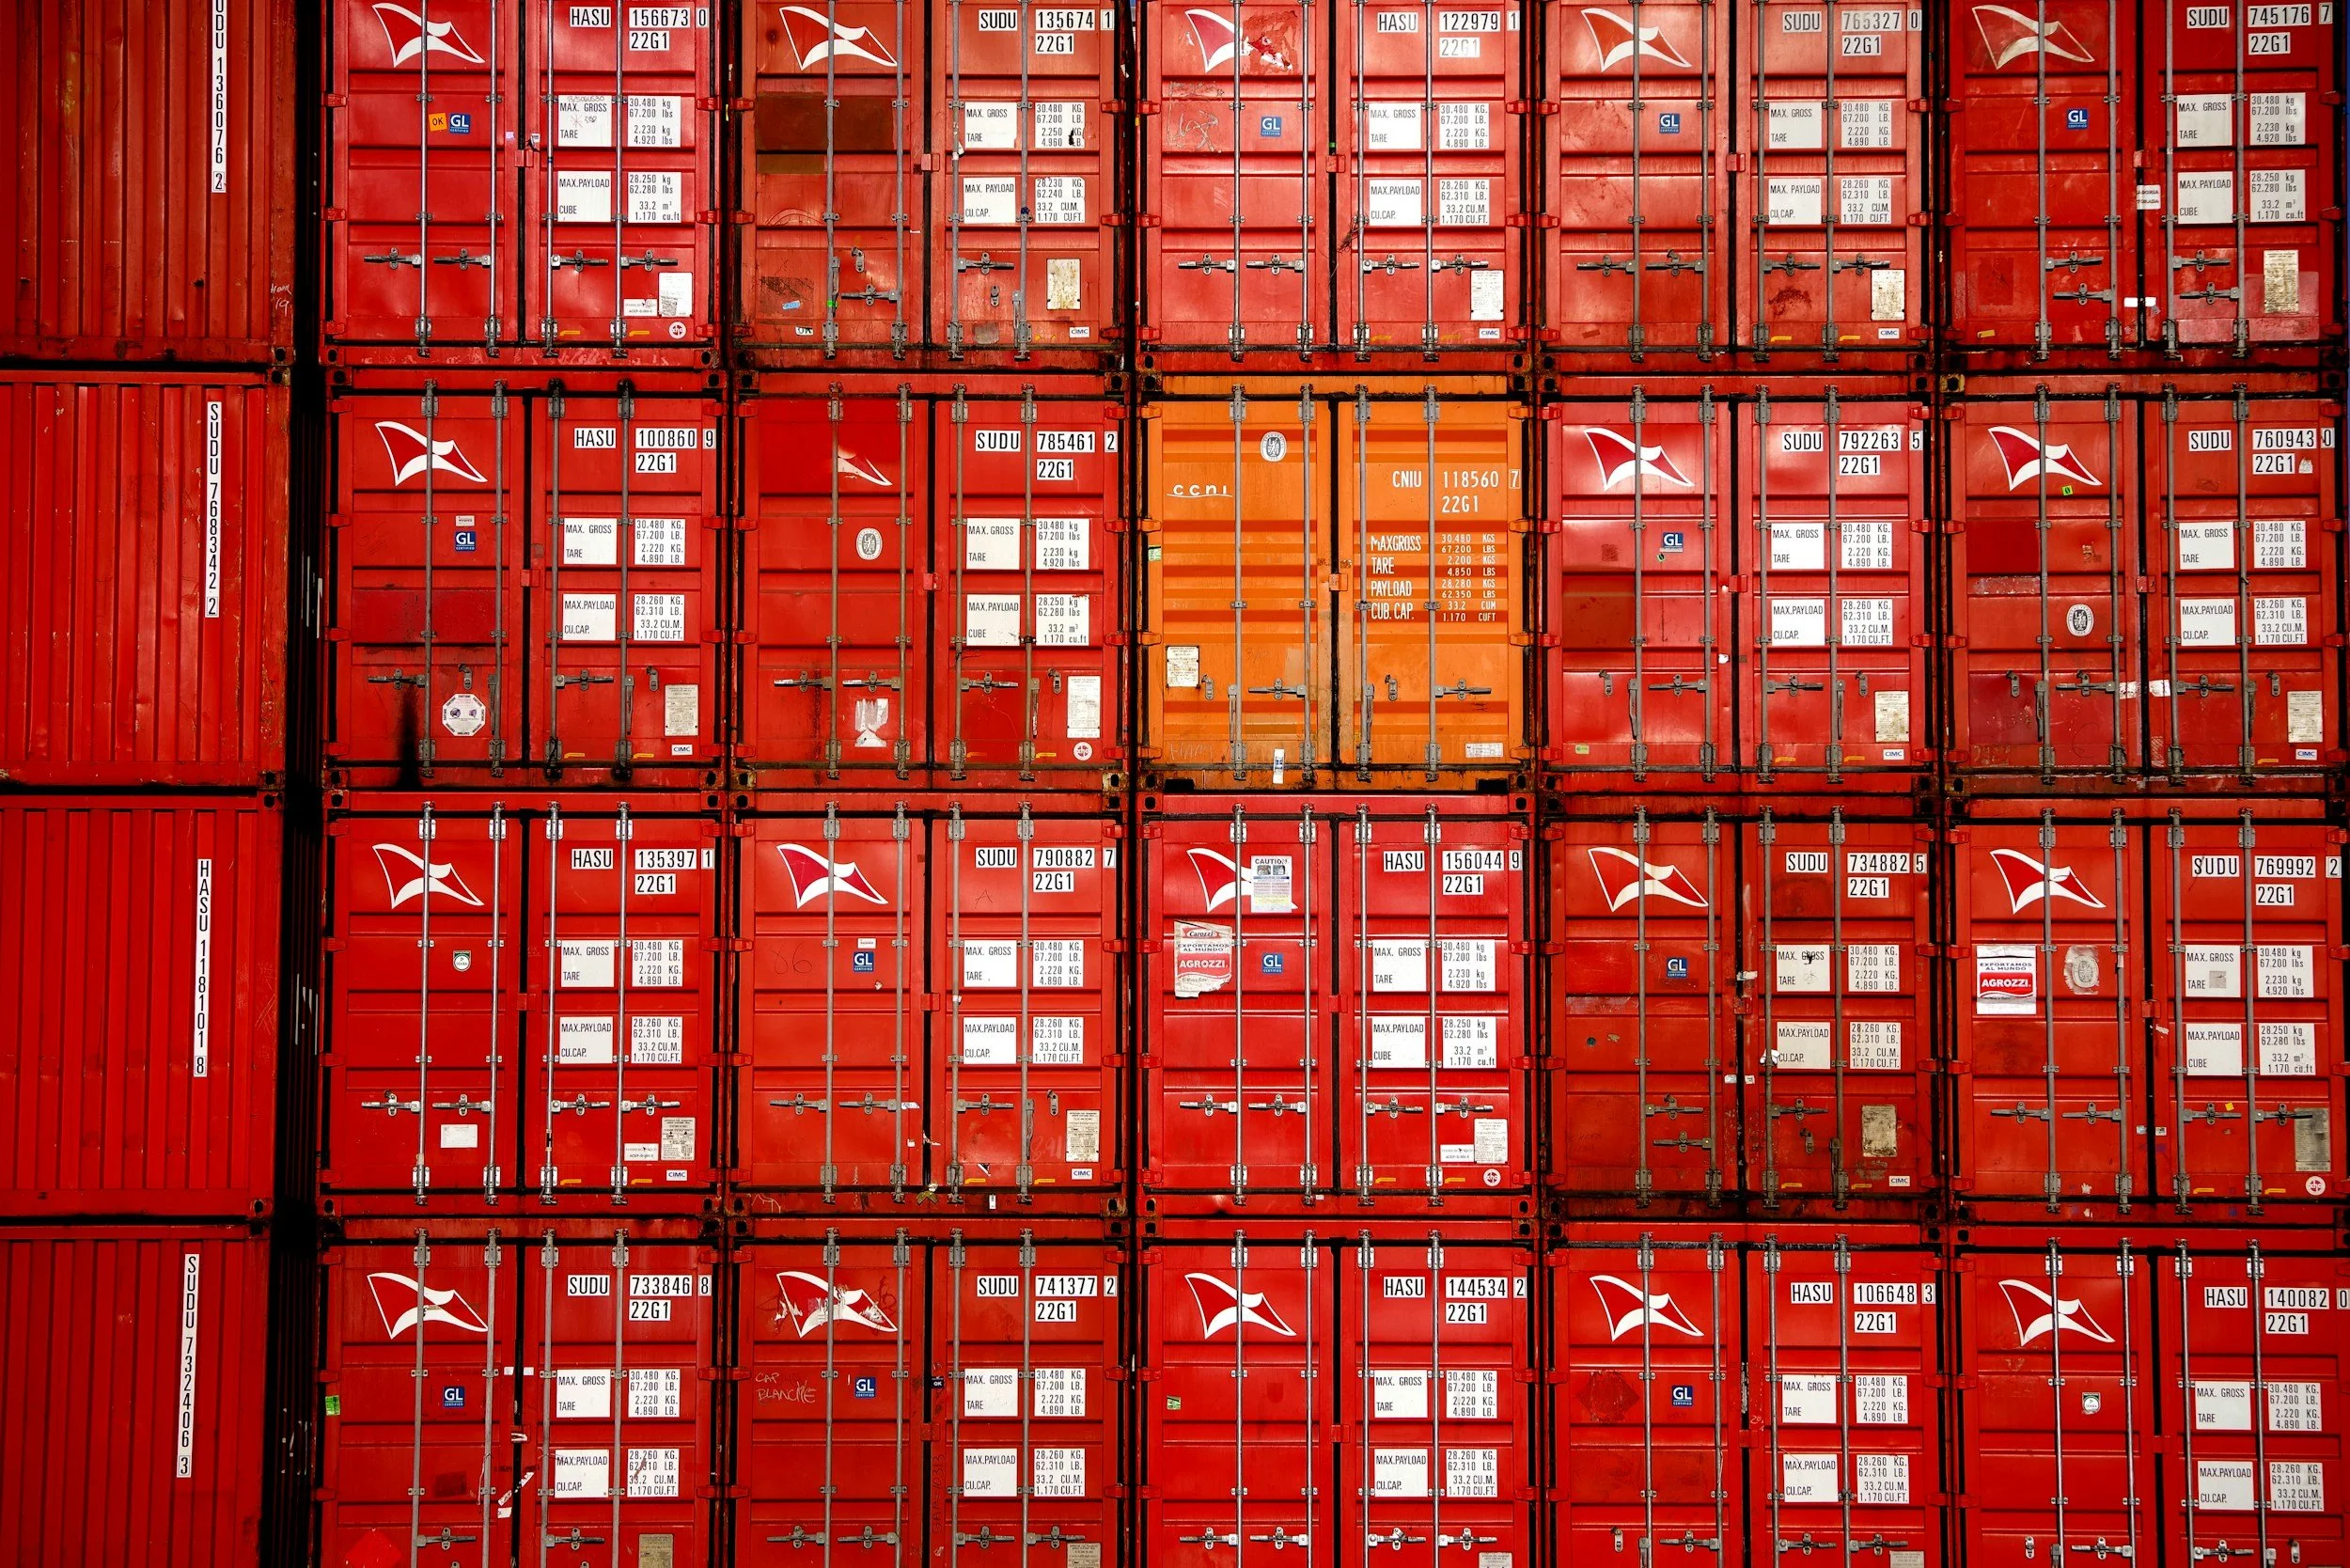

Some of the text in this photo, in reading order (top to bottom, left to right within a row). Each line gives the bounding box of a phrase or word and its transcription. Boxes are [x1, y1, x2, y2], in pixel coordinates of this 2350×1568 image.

[572, 8, 707, 26] HASU 156673 0
[979, 10, 1111, 30] SUDU 135674 1
[1378, 12, 1517, 32] HASU 122979 1
[1783, 11, 1919, 32] SUDU 765327 0
[2188, 5, 2330, 27] SUDU 745176 7
[631, 32, 668, 50] 22G1
[2250, 34, 2289, 54] 22G1
[215, 57, 224, 164] 136076
[560, 103, 607, 112] MAX. GROSS
[629, 99, 671, 109] 30.480 kg
[432, 118, 444, 126] OK
[450, 115, 469, 127] GL
[629, 109, 672, 118] 67.200 lbs
[2069, 110, 2088, 122] GL
[1261, 118, 1280, 131] GL
[560, 130, 578, 139] TARE
[215, 173, 223, 190] 2
[559, 205, 577, 214] CUBE
[575, 430, 713, 447] HASU 100860 9
[977, 431, 1116, 451] SUDU 785461 2
[1783, 431, 1920, 450] SUDU 792263 5
[2190, 429, 2332, 450] SUDU 760943 0
[2255, 455, 2295, 474] 22G1
[1392, 470, 1519, 488] CNIU 118560 7
[209, 403, 218, 615] SUDU 768342 2
[1442, 494, 1480, 513] 22G1
[456, 532, 475, 544] GL
[1441, 533, 1496, 543] 30.480 KGS
[1664, 534, 1683, 546] GL
[2181, 528, 2228, 538] MAX. GROSS
[1441, 544, 1496, 554] 67.200 LBS
[1371, 557, 1394, 574] TARE
[1448, 555, 1496, 565] 2.200 KGS
[2182, 554, 2200, 563] TARE
[1448, 567, 1496, 576] 4.850 LBS
[1371, 580, 1412, 597] PAYLOAD
[1441, 578, 1496, 588] 28.280 KGS
[1441, 590, 1496, 599] 62.350 LBS
[1371, 602, 1415, 619] CUB. CAP.
[1448, 601, 1496, 610] 33.2 CUM
[1443, 612, 1496, 622] 1.170 CUFT
[572, 850, 712, 869] HASU 135397 1
[977, 849, 1114, 867] SUDU 790882 7
[1385, 852, 1520, 870] HASU 156044 9
[1787, 854, 1924, 872] SUDU 734882 5
[2193, 857, 2339, 877] SUDU 769992 2
[1035, 872, 1073, 890] 22G1
[1849, 879, 1888, 897] 22G1
[854, 953, 872, 965] GL
[1374, 947, 1421, 956] MAX. GROSS
[196, 860, 210, 1074] HASU 118101 8
[1668, 959, 1686, 971] GL
[1374, 974, 1393, 983] TARE
[1373, 1051, 1392, 1060] CUBE
[569, 1276, 710, 1295] SUDU 733846 8
[979, 1277, 1115, 1295] SUDU 741377 2
[1386, 1278, 1525, 1296] HASU 144534 2
[1792, 1283, 1934, 1303] HASU 106648 3
[2206, 1288, 2348, 1308] HASU 140082 0
[631, 1301, 669, 1319] 22G1
[180, 1256, 196, 1475] SUDU 732406 3
[856, 1379, 875, 1392] GL
[965, 1375, 1012, 1385] MAX. GROSS
[966, 1401, 983, 1410] TARE
